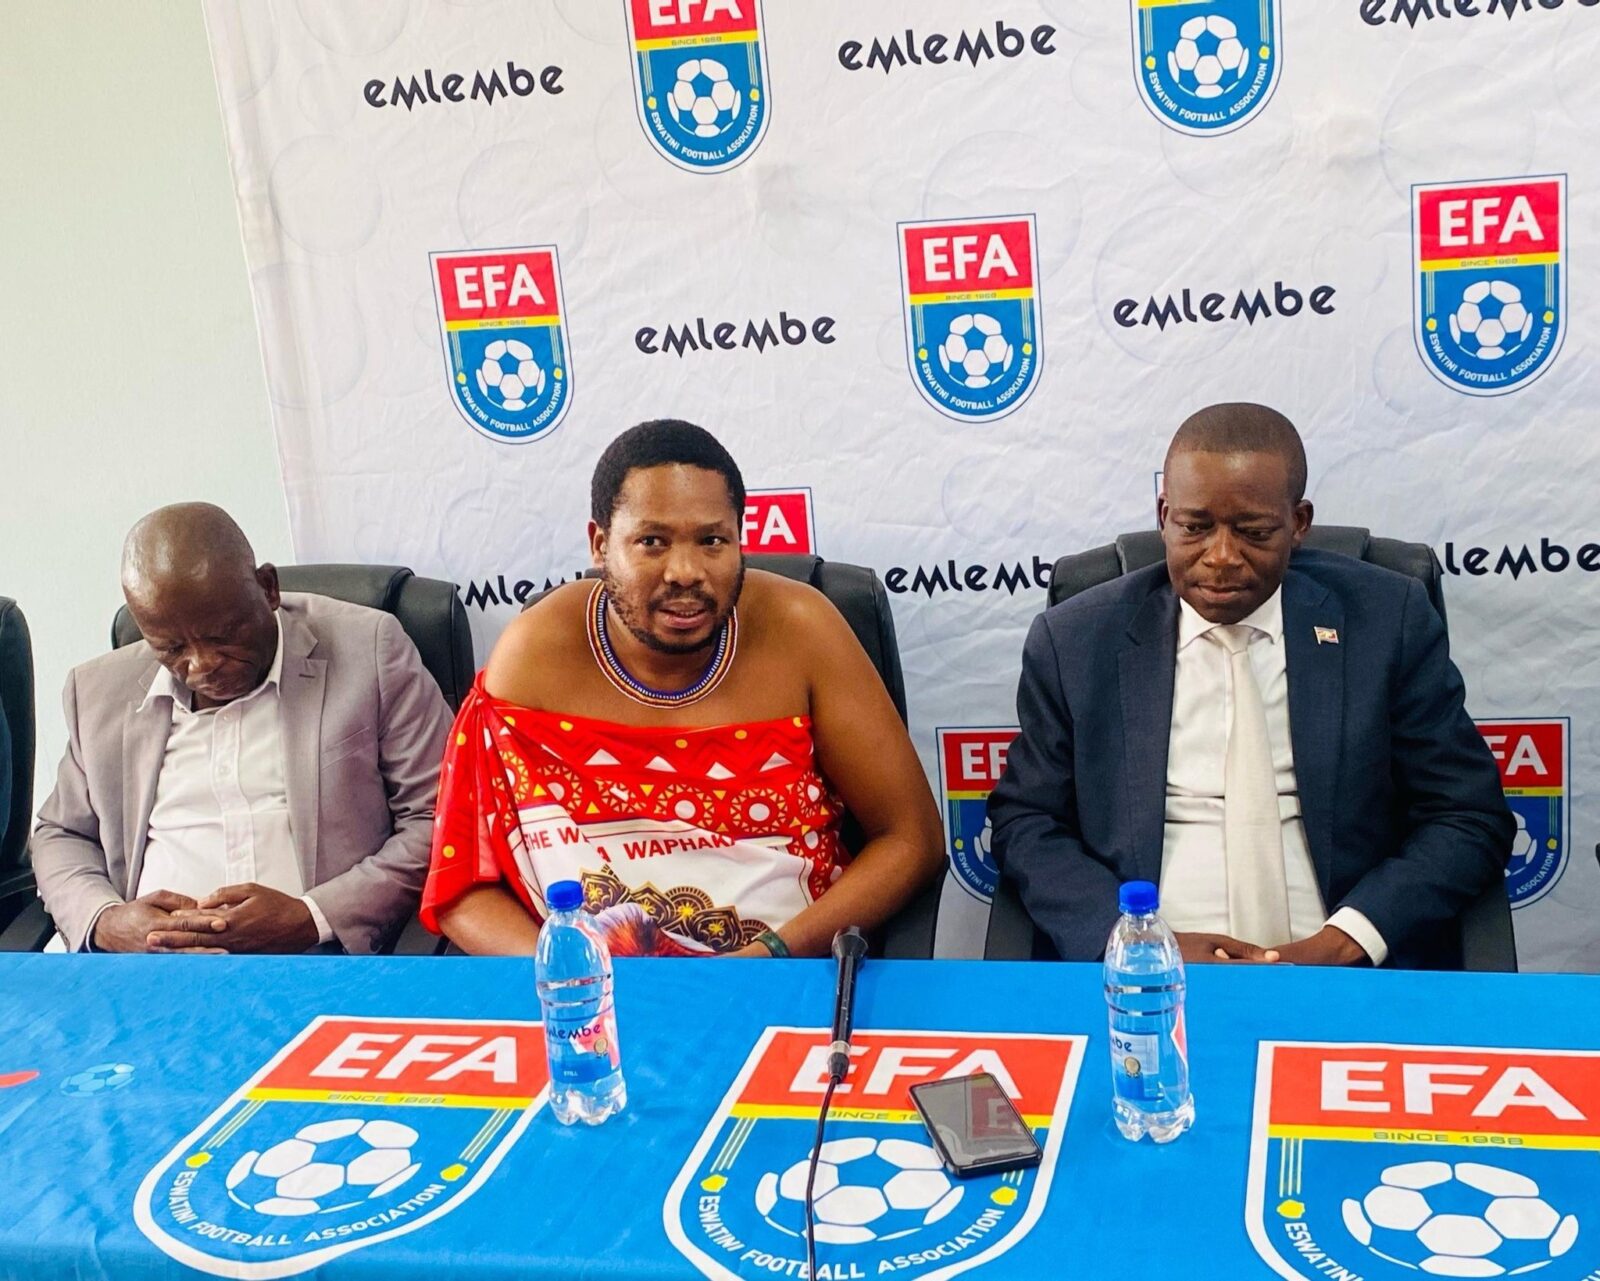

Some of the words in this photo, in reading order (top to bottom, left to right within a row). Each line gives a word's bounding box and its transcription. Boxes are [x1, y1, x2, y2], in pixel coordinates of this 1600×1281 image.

[1148, 71, 1178, 112] ESWATINI
[1178, 109, 1227, 123] FOOTBALL
[1229, 63, 1268, 116] ASSOCIATION
[651, 112, 679, 150] ESWATINI
[681, 148, 725, 161] FOOTBALL
[726, 104, 759, 155] ASSOCIATION
[1438, 195, 1545, 247] EFA
[923, 234, 1019, 282] EFA
[453, 263, 546, 309] EFA
[1429, 333, 1457, 372] ESWATINI
[1458, 368, 1508, 383] FOOTBALL
[1510, 326, 1551, 377] ASSOCIATION
[461, 386, 489, 422] ESWATINI
[489, 418, 530, 432] FOOTBALL
[533, 382, 562, 427] ASSOCIATION
[921, 363, 949, 400] ESWATINI
[949, 396, 994, 410] FOOTBALL
[996, 358, 1030, 405] ASSOCIATION
[740, 505, 798, 546] FA
[884, 556, 1053, 599] emlemb
[1430, 538, 1600, 581] lembe
[960, 742, 1012, 780] EF
[1516, 852, 1554, 895] ASSOCIATION
[309, 1032, 518, 1084] EFA
[327, 1094, 389, 1103] SINCE
[1321, 1060, 1588, 1121] EFA
[1373, 1131, 1449, 1143] SINCE
[1460, 1135, 1523, 1146] 1968
[169, 1171, 198, 1225] ESWATINI
[187, 1221, 293, 1247] FOOTBALL
[304, 1183, 447, 1242] ASSOCIATION
[699, 1195, 745, 1253] ESWATINI
[740, 1249, 865, 1281] FOOTBALL
[877, 1208, 1005, 1275] ASSOCIATION
